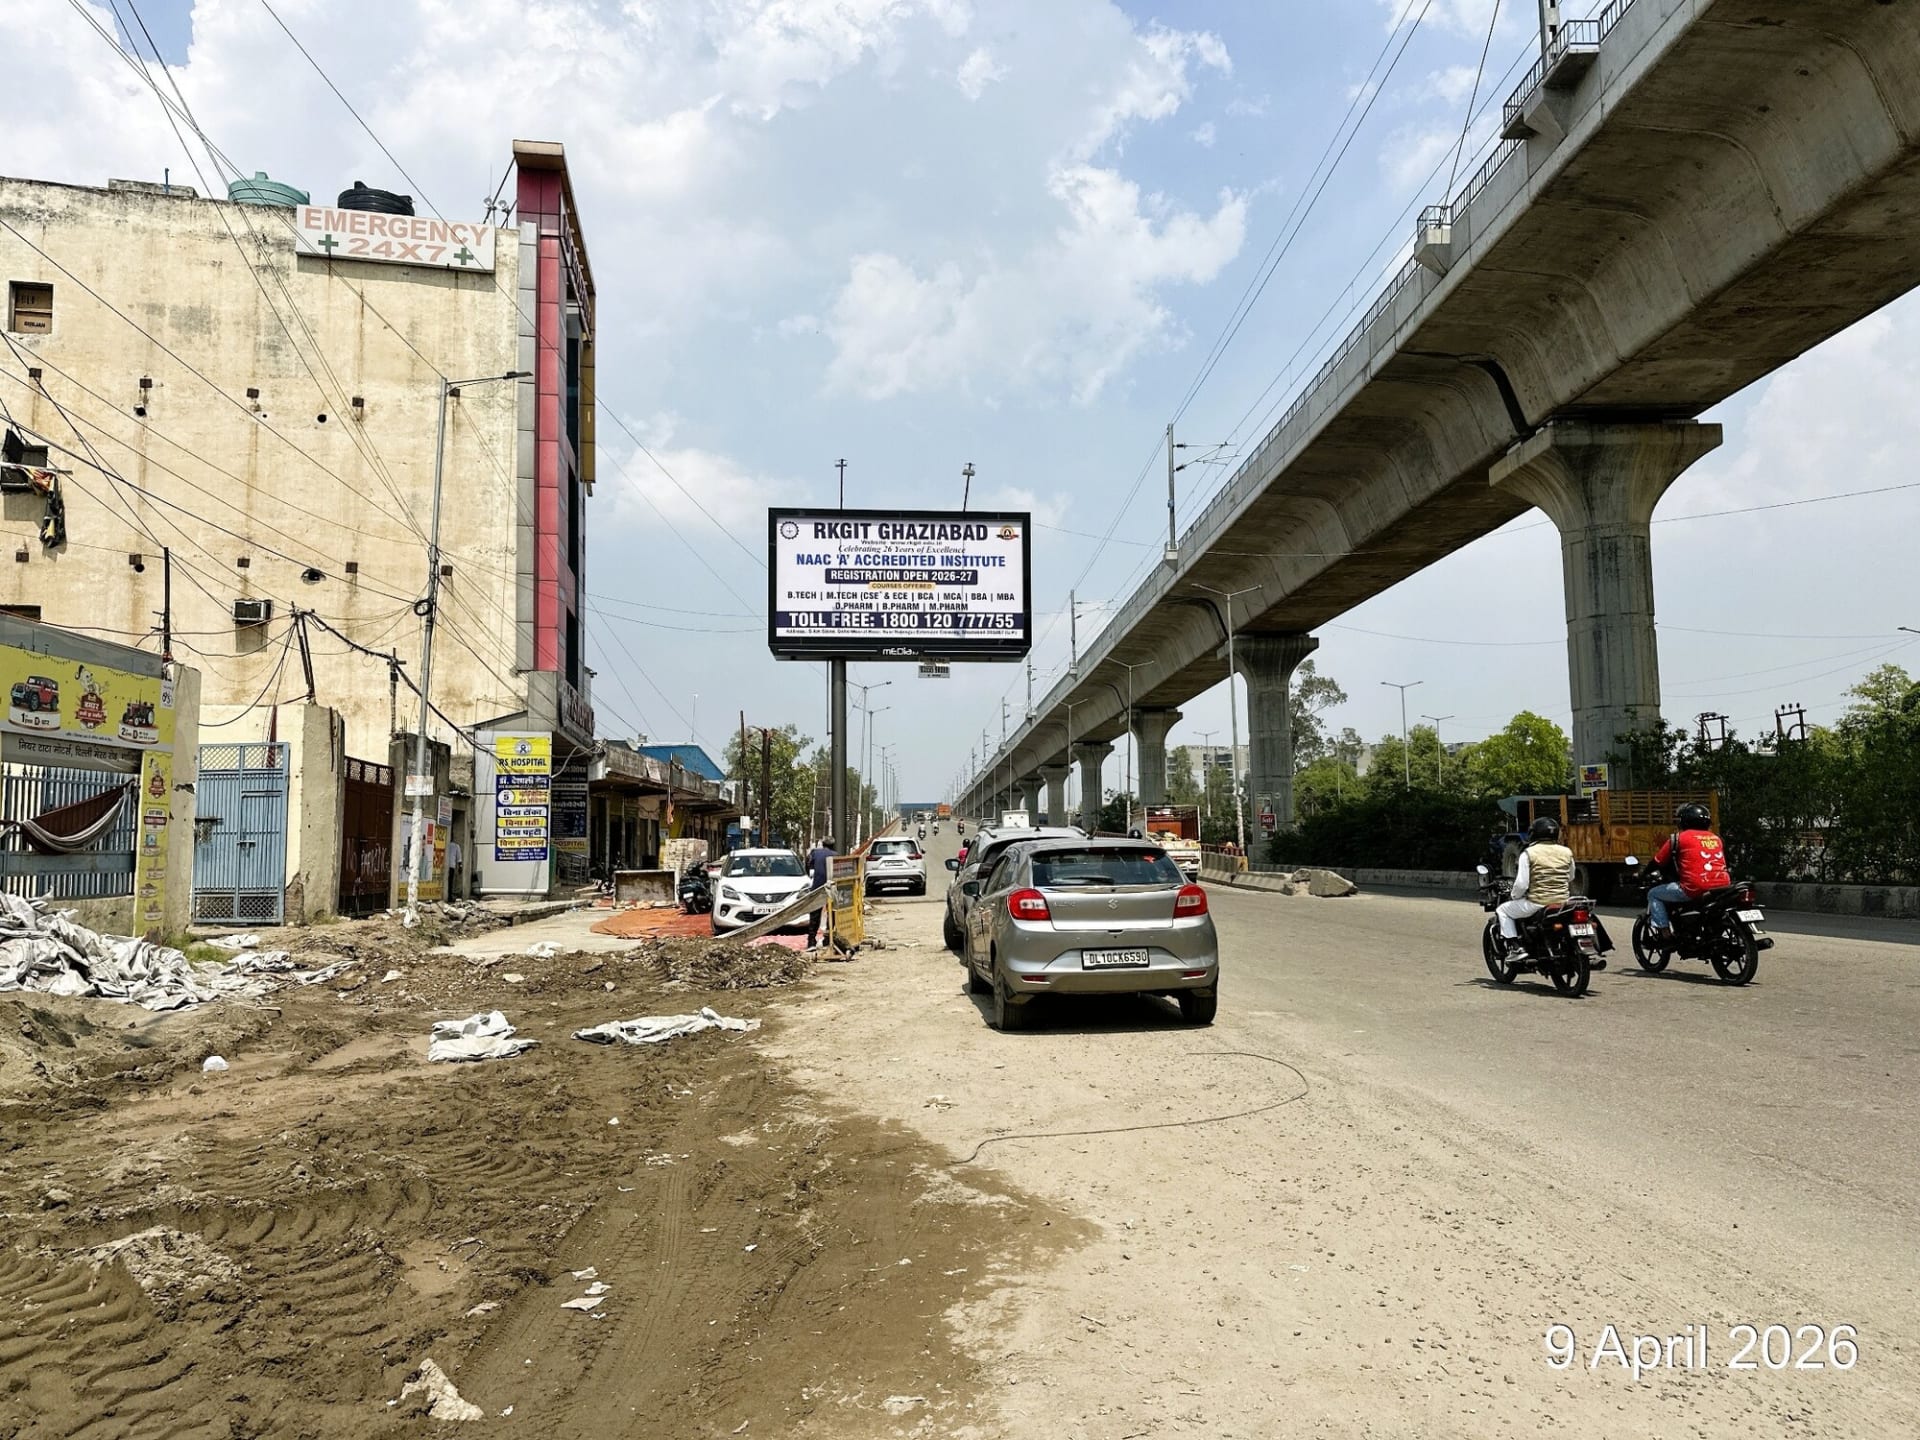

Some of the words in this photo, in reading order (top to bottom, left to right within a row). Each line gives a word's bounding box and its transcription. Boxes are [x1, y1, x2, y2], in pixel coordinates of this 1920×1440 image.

[304, 207, 489, 247] EMERGENCY
[347, 237, 447, 262] 24X7
[813, 522, 872, 540] RKGIT
[877, 522, 988, 541] GHAZIABAD
[838, 544, 881, 554] Celebrating
[883, 545, 893, 553] 26
[916, 546, 925, 554] of
[926, 546, 966, 554] Excellence
[796, 553, 831, 565] NAAC
[854, 554, 936, 566] ACCREDITED
[941, 555, 1006, 567] INSTITUTE
[830, 570, 900, 581] REGISTRATION
[903, 571, 928, 581] OPEN
[931, 571, 972, 581] 2026-27
[787, 591, 817, 600] B.TECH
[826, 592, 858, 600] M.TECH
[893, 592, 908, 600] ECE
[917, 592, 934, 600] BCA
[943, 592, 962, 601] MCA
[971, 593, 987, 601] BBA
[996, 593, 1015, 601] MBA
[835, 602, 873, 610] D.PHARM
[882, 602, 920, 611] B.PHARM
[929, 603, 969, 611] M.PHARM
[788, 613, 827, 627] TOLL
[832, 613, 875, 628] FREE:
[880, 613, 918, 628] 1800
[924, 614, 952, 628] 120
[956, 614, 1014, 629] 777755
[38, 744, 52, 753] टाटा
[511, 758, 547, 767] HOSPITAL
